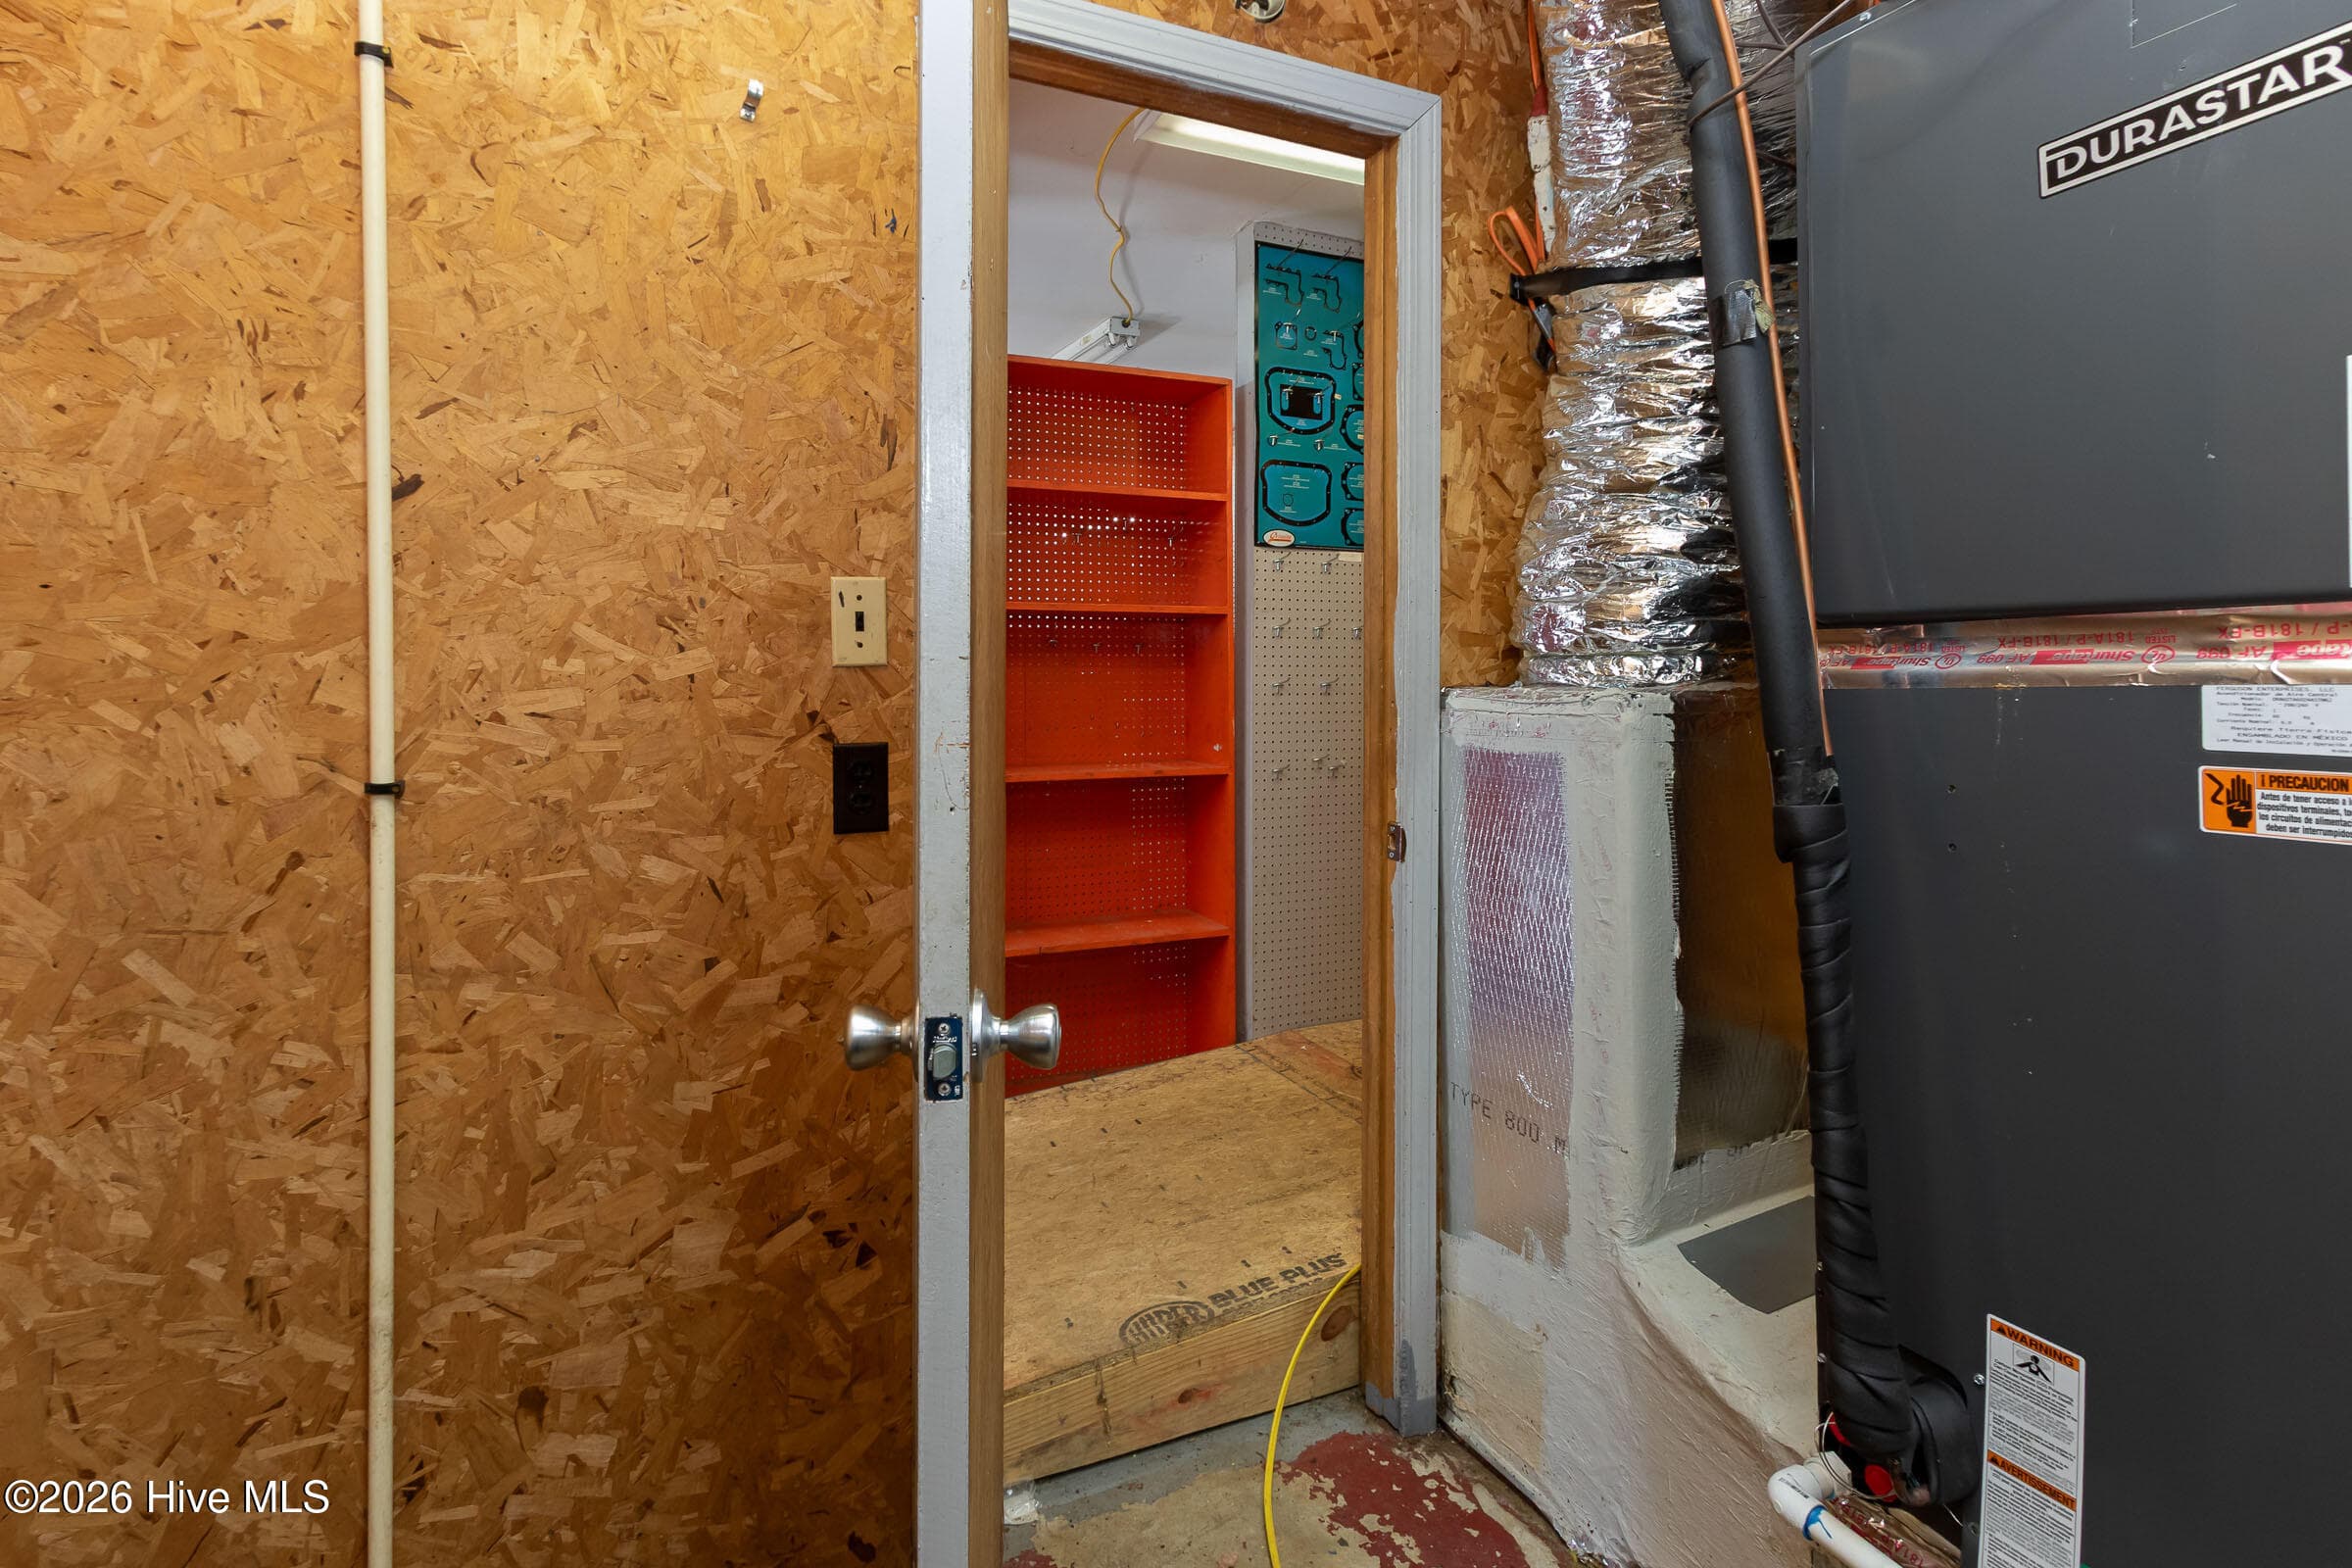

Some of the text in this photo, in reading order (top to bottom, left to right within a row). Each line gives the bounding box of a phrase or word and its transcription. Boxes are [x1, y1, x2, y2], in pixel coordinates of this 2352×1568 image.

[2056, 44, 2352, 180] DURASTAR
[1998, 634, 2059, 649] 181B-FX
[2076, 630, 2133, 646] 181A-P
[1977, 653, 2005, 664] 099
[2007, 653, 2030, 663] AF
[2269, 774, 2350, 792] PRECAUCION
[2261, 791, 2280, 802] Antes
[2282, 792, 2291, 802] de
[2293, 794, 2312, 804] tener
[2314, 797, 2340, 806] acceso
[2257, 802, 2299, 813] dispositivos
[2259, 812, 2270, 821] los
[2271, 813, 2302, 824] circuitos
[2304, 815, 2314, 825] de
[2265, 823, 2287, 833] deben
[2288, 825, 2301, 834] ser
[1450, 1081, 1494, 1119] TYPE
[1504, 1109, 1541, 1144] 800
[1207, 1275, 1280, 1309] BLUE
[1279, 1252, 1348, 1284] PLUS
[2005, 1327, 2075, 1368] WARNING
